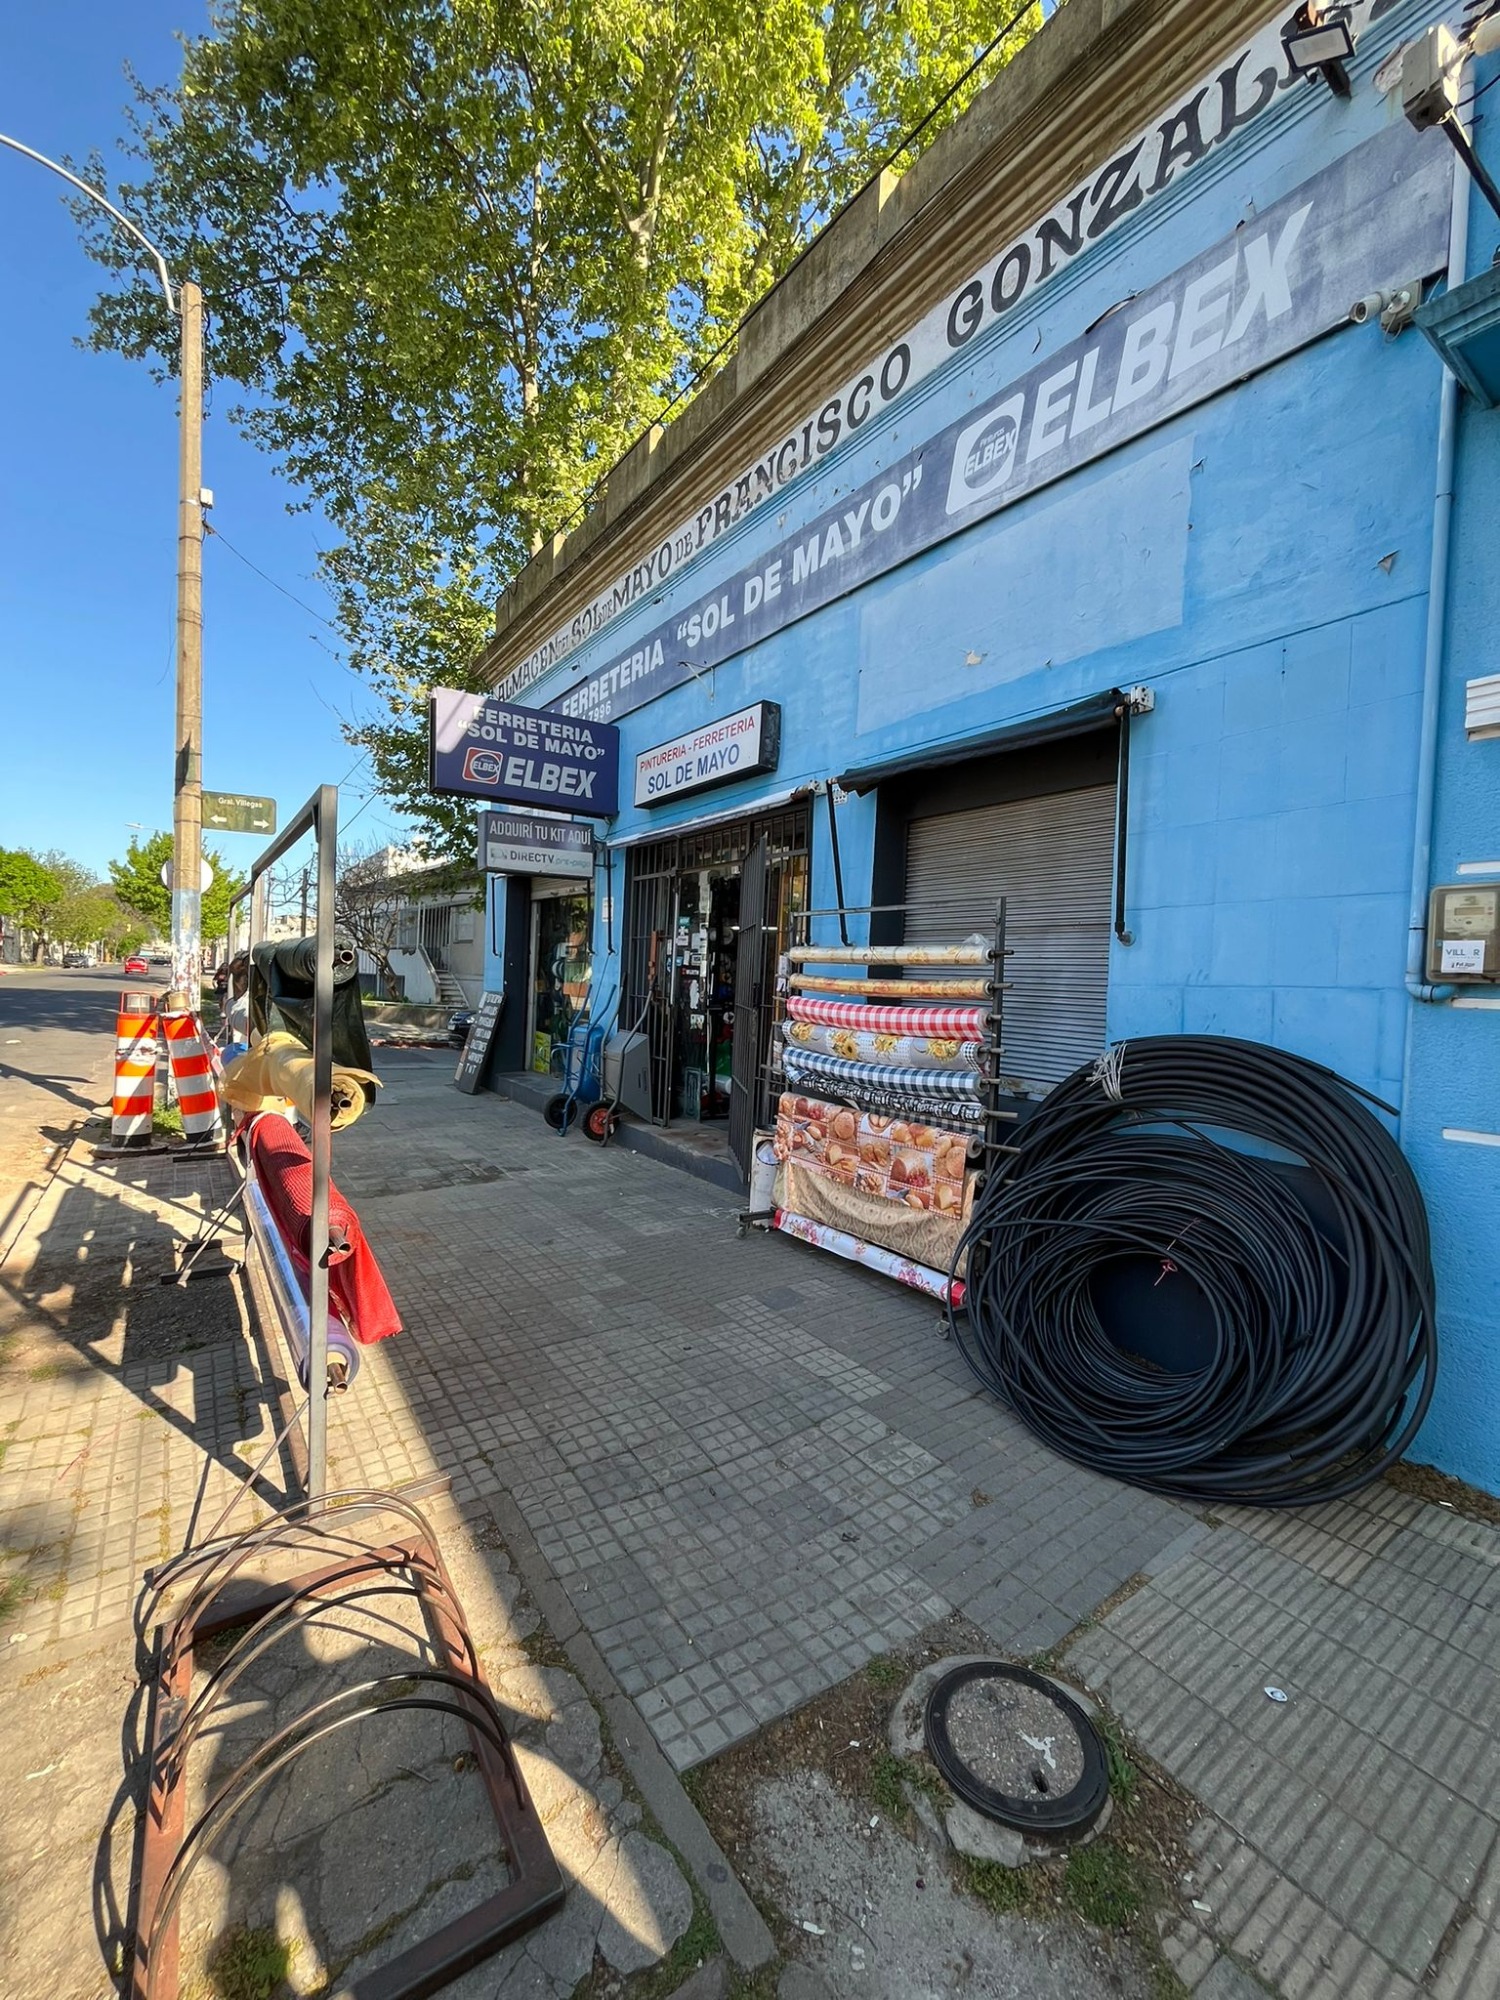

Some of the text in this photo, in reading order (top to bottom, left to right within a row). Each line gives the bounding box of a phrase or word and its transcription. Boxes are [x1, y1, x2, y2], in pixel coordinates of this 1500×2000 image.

[1026, 201, 1314, 465] ELBEX
[964, 427, 1017, 478] ELBEX
[571, 602, 602, 647] SOL
[612, 541, 673, 614] MAYO
[675, 531, 693, 564] DE
[695, 343, 911, 550] FRANCISCO
[562, 638, 665, 717] FERRETERIA
[743, 559, 782, 616] DE
[473, 706, 594, 744] FERRETERIA
[582, 700, 612, 721] 7996
[513, 731, 539, 750] DE
[640, 744, 687, 773] PINTURERIA
[693, 715, 755, 751] FERRETERIA
[473, 760, 501, 773] ELBEX
[503, 756, 597, 799] ELBEX
[648, 743, 740, 795] SOL DE MAYO
[235, 799, 263, 809] Villegas
[489, 820, 591, 845] ADQUIRÍ TU KIT AQUÍ
[510, 850, 555, 864] DIRECTV
